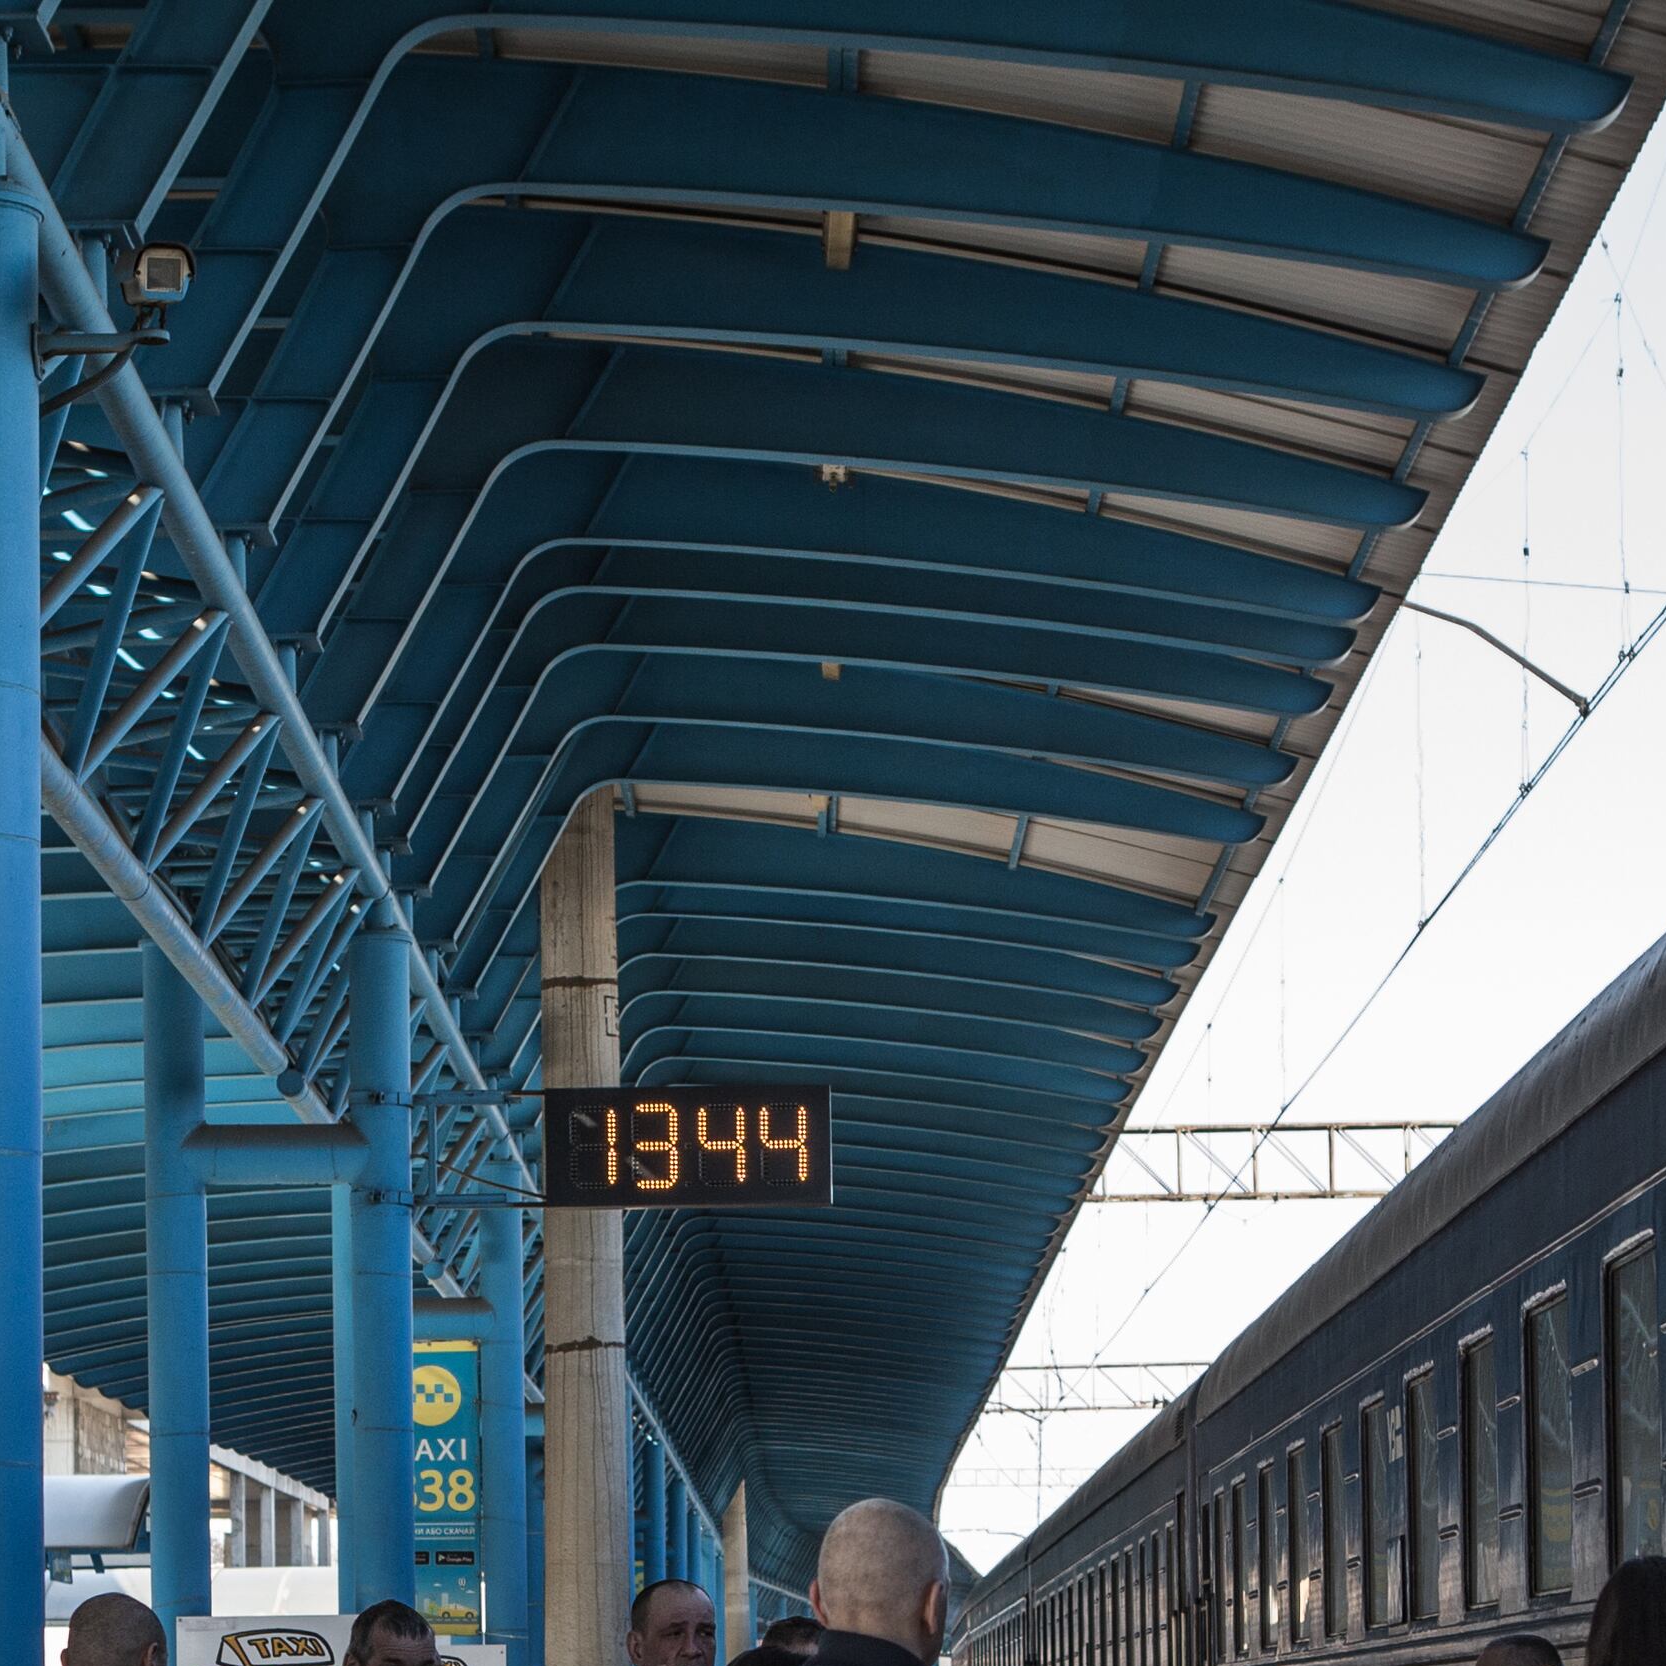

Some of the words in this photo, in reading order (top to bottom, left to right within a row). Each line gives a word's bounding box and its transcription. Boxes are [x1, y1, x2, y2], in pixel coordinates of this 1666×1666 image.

[415, 1438, 467, 1461] AXI
[414, 1468, 476, 1512] 38
[248, 1636, 325, 1659] TAXI
